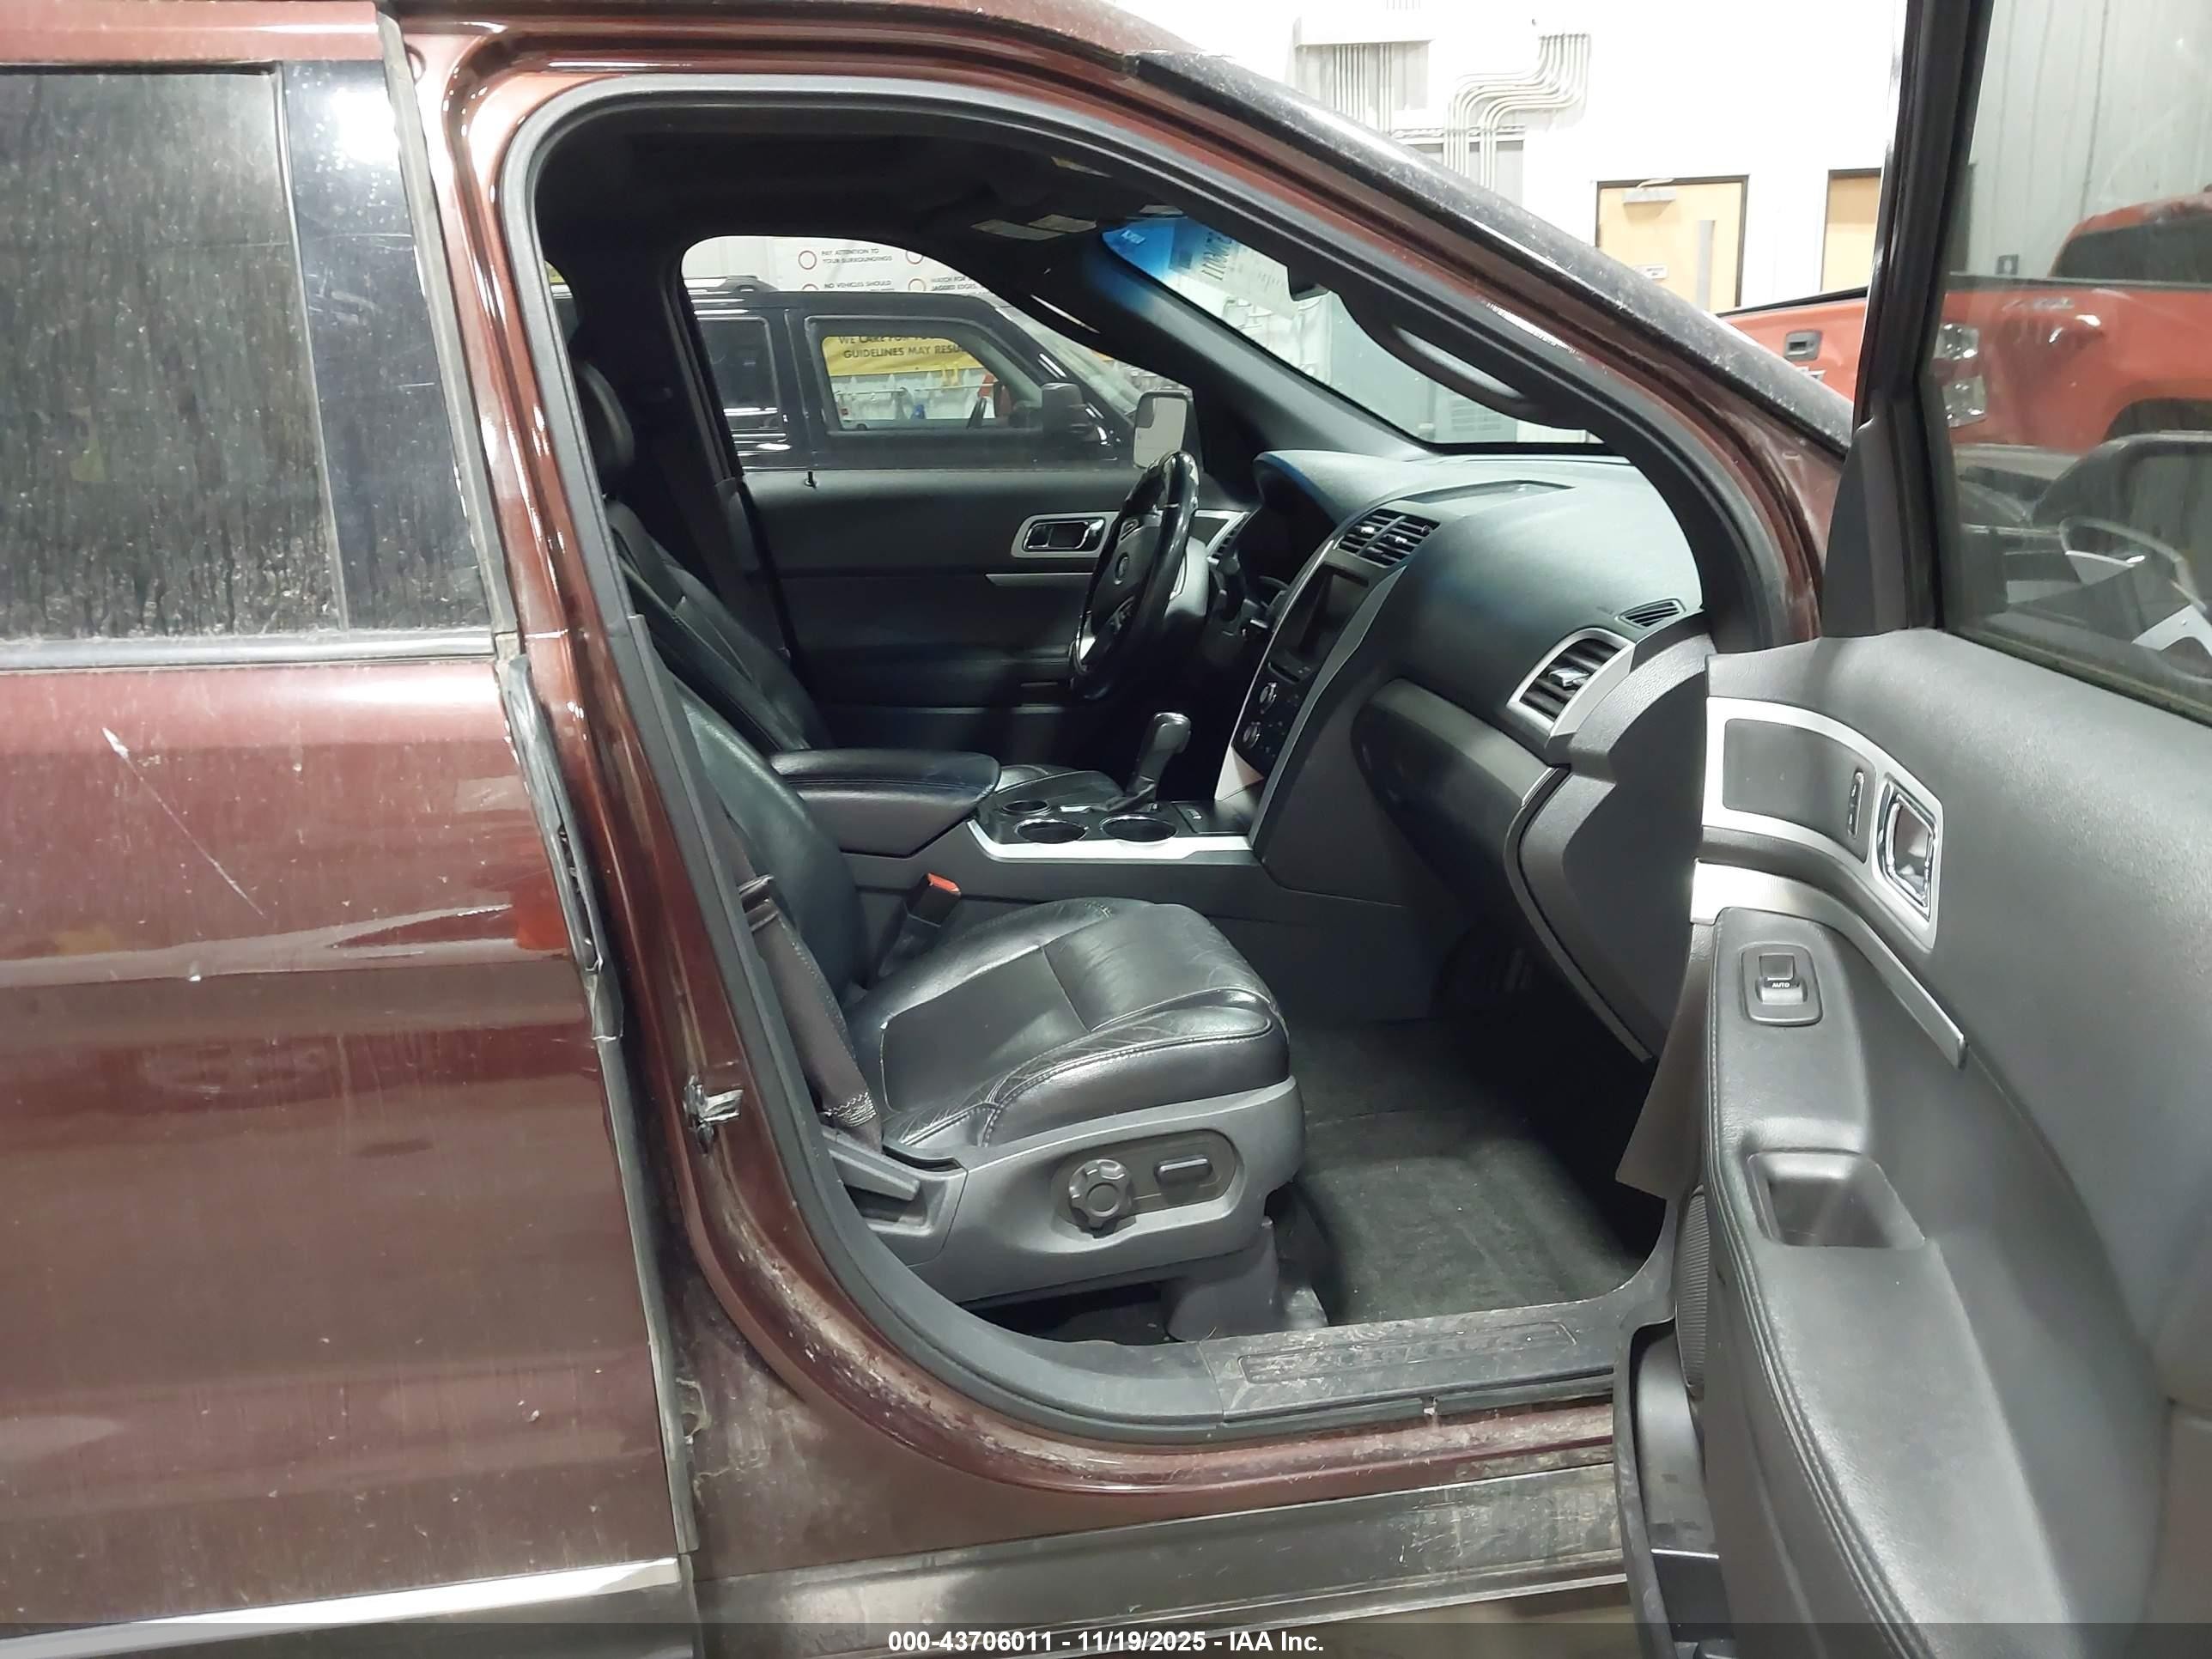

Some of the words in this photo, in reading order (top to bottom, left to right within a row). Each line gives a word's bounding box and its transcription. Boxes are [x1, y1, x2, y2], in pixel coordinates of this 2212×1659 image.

[838, 336, 855, 344] WE
[843, 347, 904, 359] GUIDELINES
[908, 345, 931, 355] MAY
